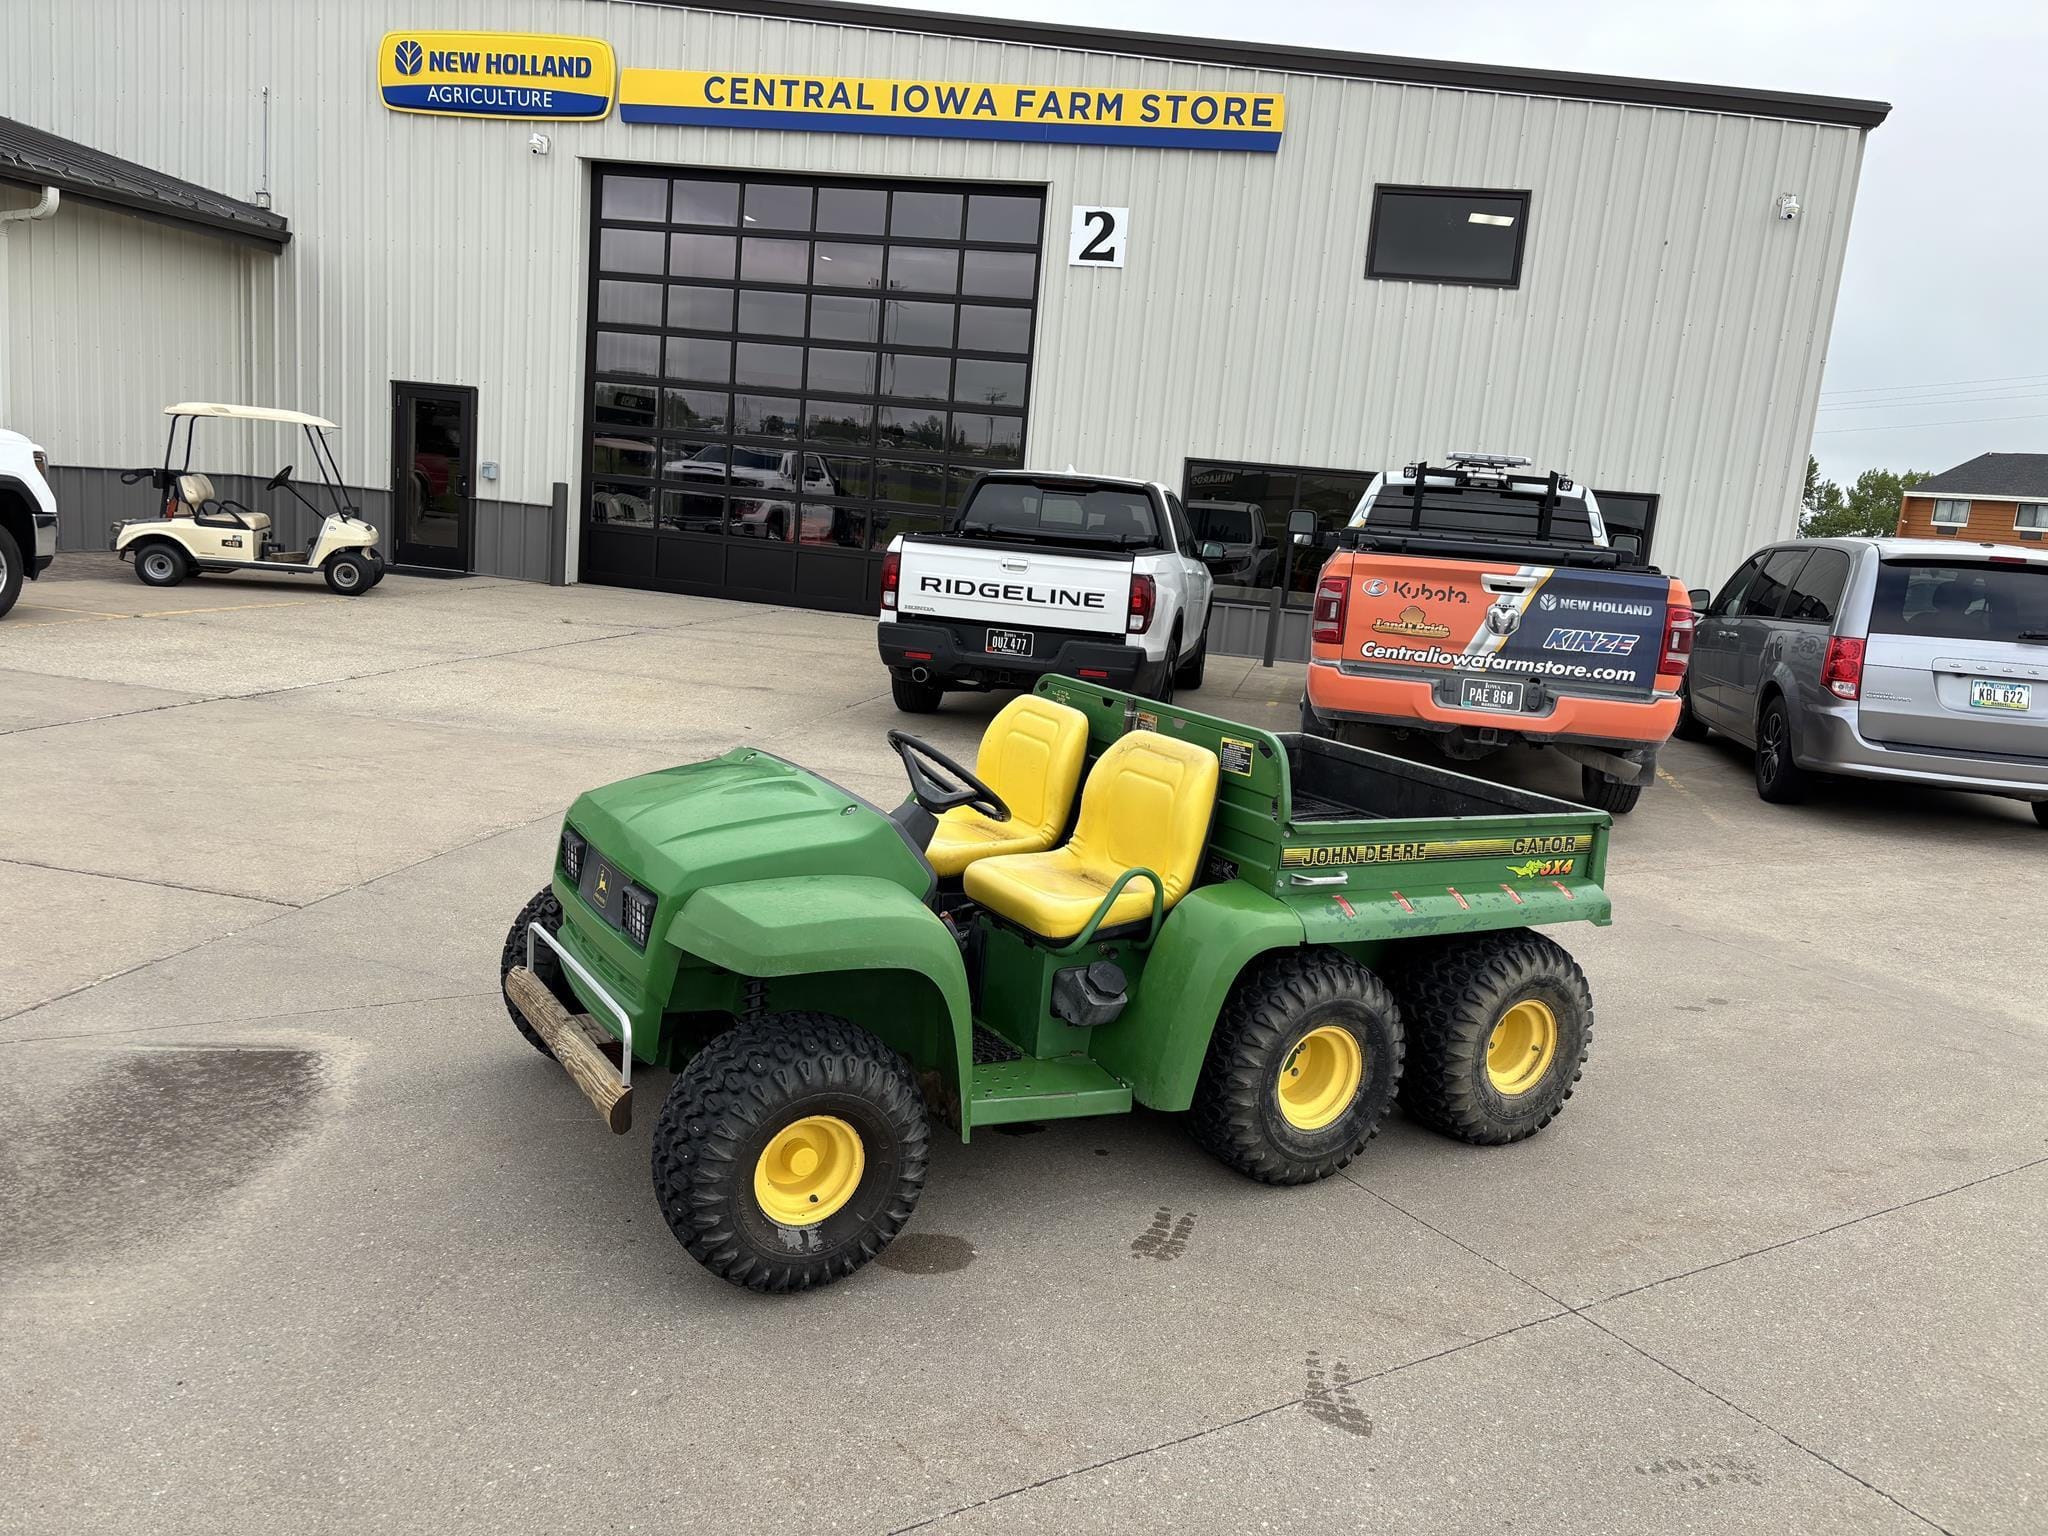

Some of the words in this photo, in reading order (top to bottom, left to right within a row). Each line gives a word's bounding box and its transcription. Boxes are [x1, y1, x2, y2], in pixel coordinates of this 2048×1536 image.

[429, 51, 480, 73] NEW
[486, 53, 592, 78] HOLLAND
[427, 86, 553, 107] AGRICULTURE
[704, 76, 874, 110] CENTRAL
[891, 84, 997, 116] IOWA
[1014, 90, 1124, 121] FARM
[1140, 94, 1274, 127] STORE
[1078, 211, 1117, 262] 2
[920, 576, 1106, 609] RIDGELINE
[1393, 581, 1467, 604] Kubota
[1560, 598, 1590, 611] NEW
[1592, 601, 1653, 616] HOLLAND
[1010, 638, 1027, 651] 477
[1543, 628, 1640, 656] KINZE
[1361, 641, 1636, 682] Centraliowafarmstore.com
[1469, 687, 1490, 703] PAE
[1979, 687, 1999, 702] KBL
[2003, 690, 2023, 704] 622
[1302, 846, 1358, 866] JOHN
[1364, 843, 1426, 862] DEERE
[1512, 837, 1576, 855] GATOR
[1540, 859, 1574, 876] 6X4
